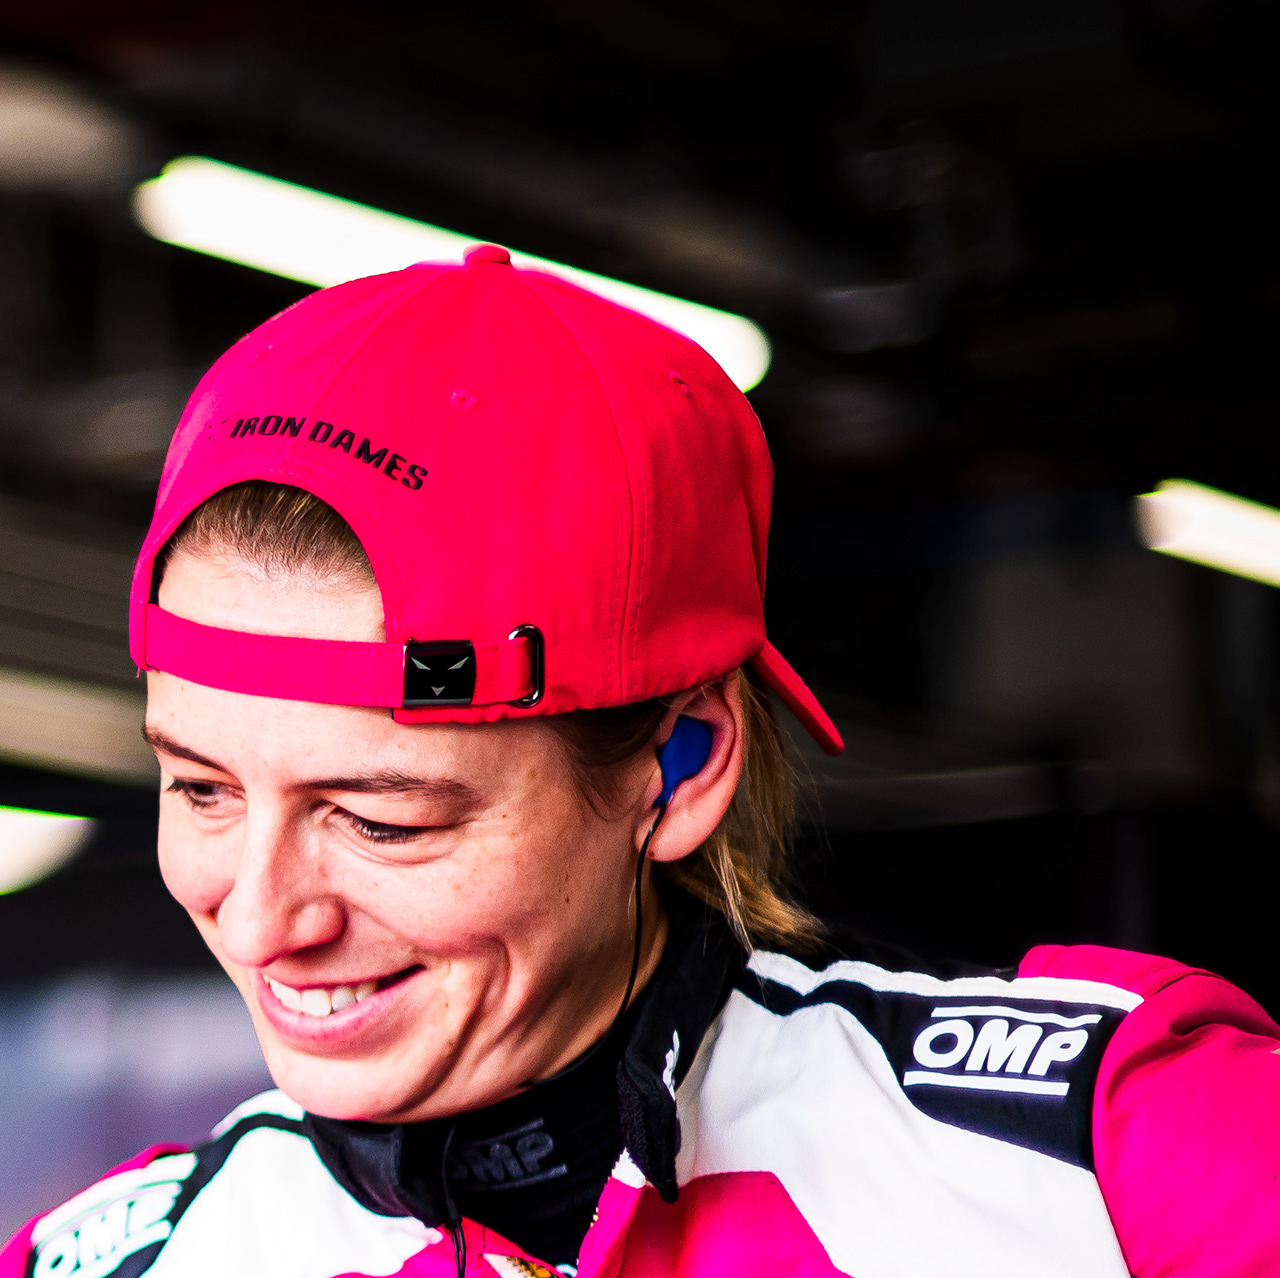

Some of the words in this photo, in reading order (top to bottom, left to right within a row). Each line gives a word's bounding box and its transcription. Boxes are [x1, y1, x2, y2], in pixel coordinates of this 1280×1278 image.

[229, 415, 306, 438] IRON
[307, 421, 428, 490] DAMES
[913, 1019, 1089, 1076] OMP
